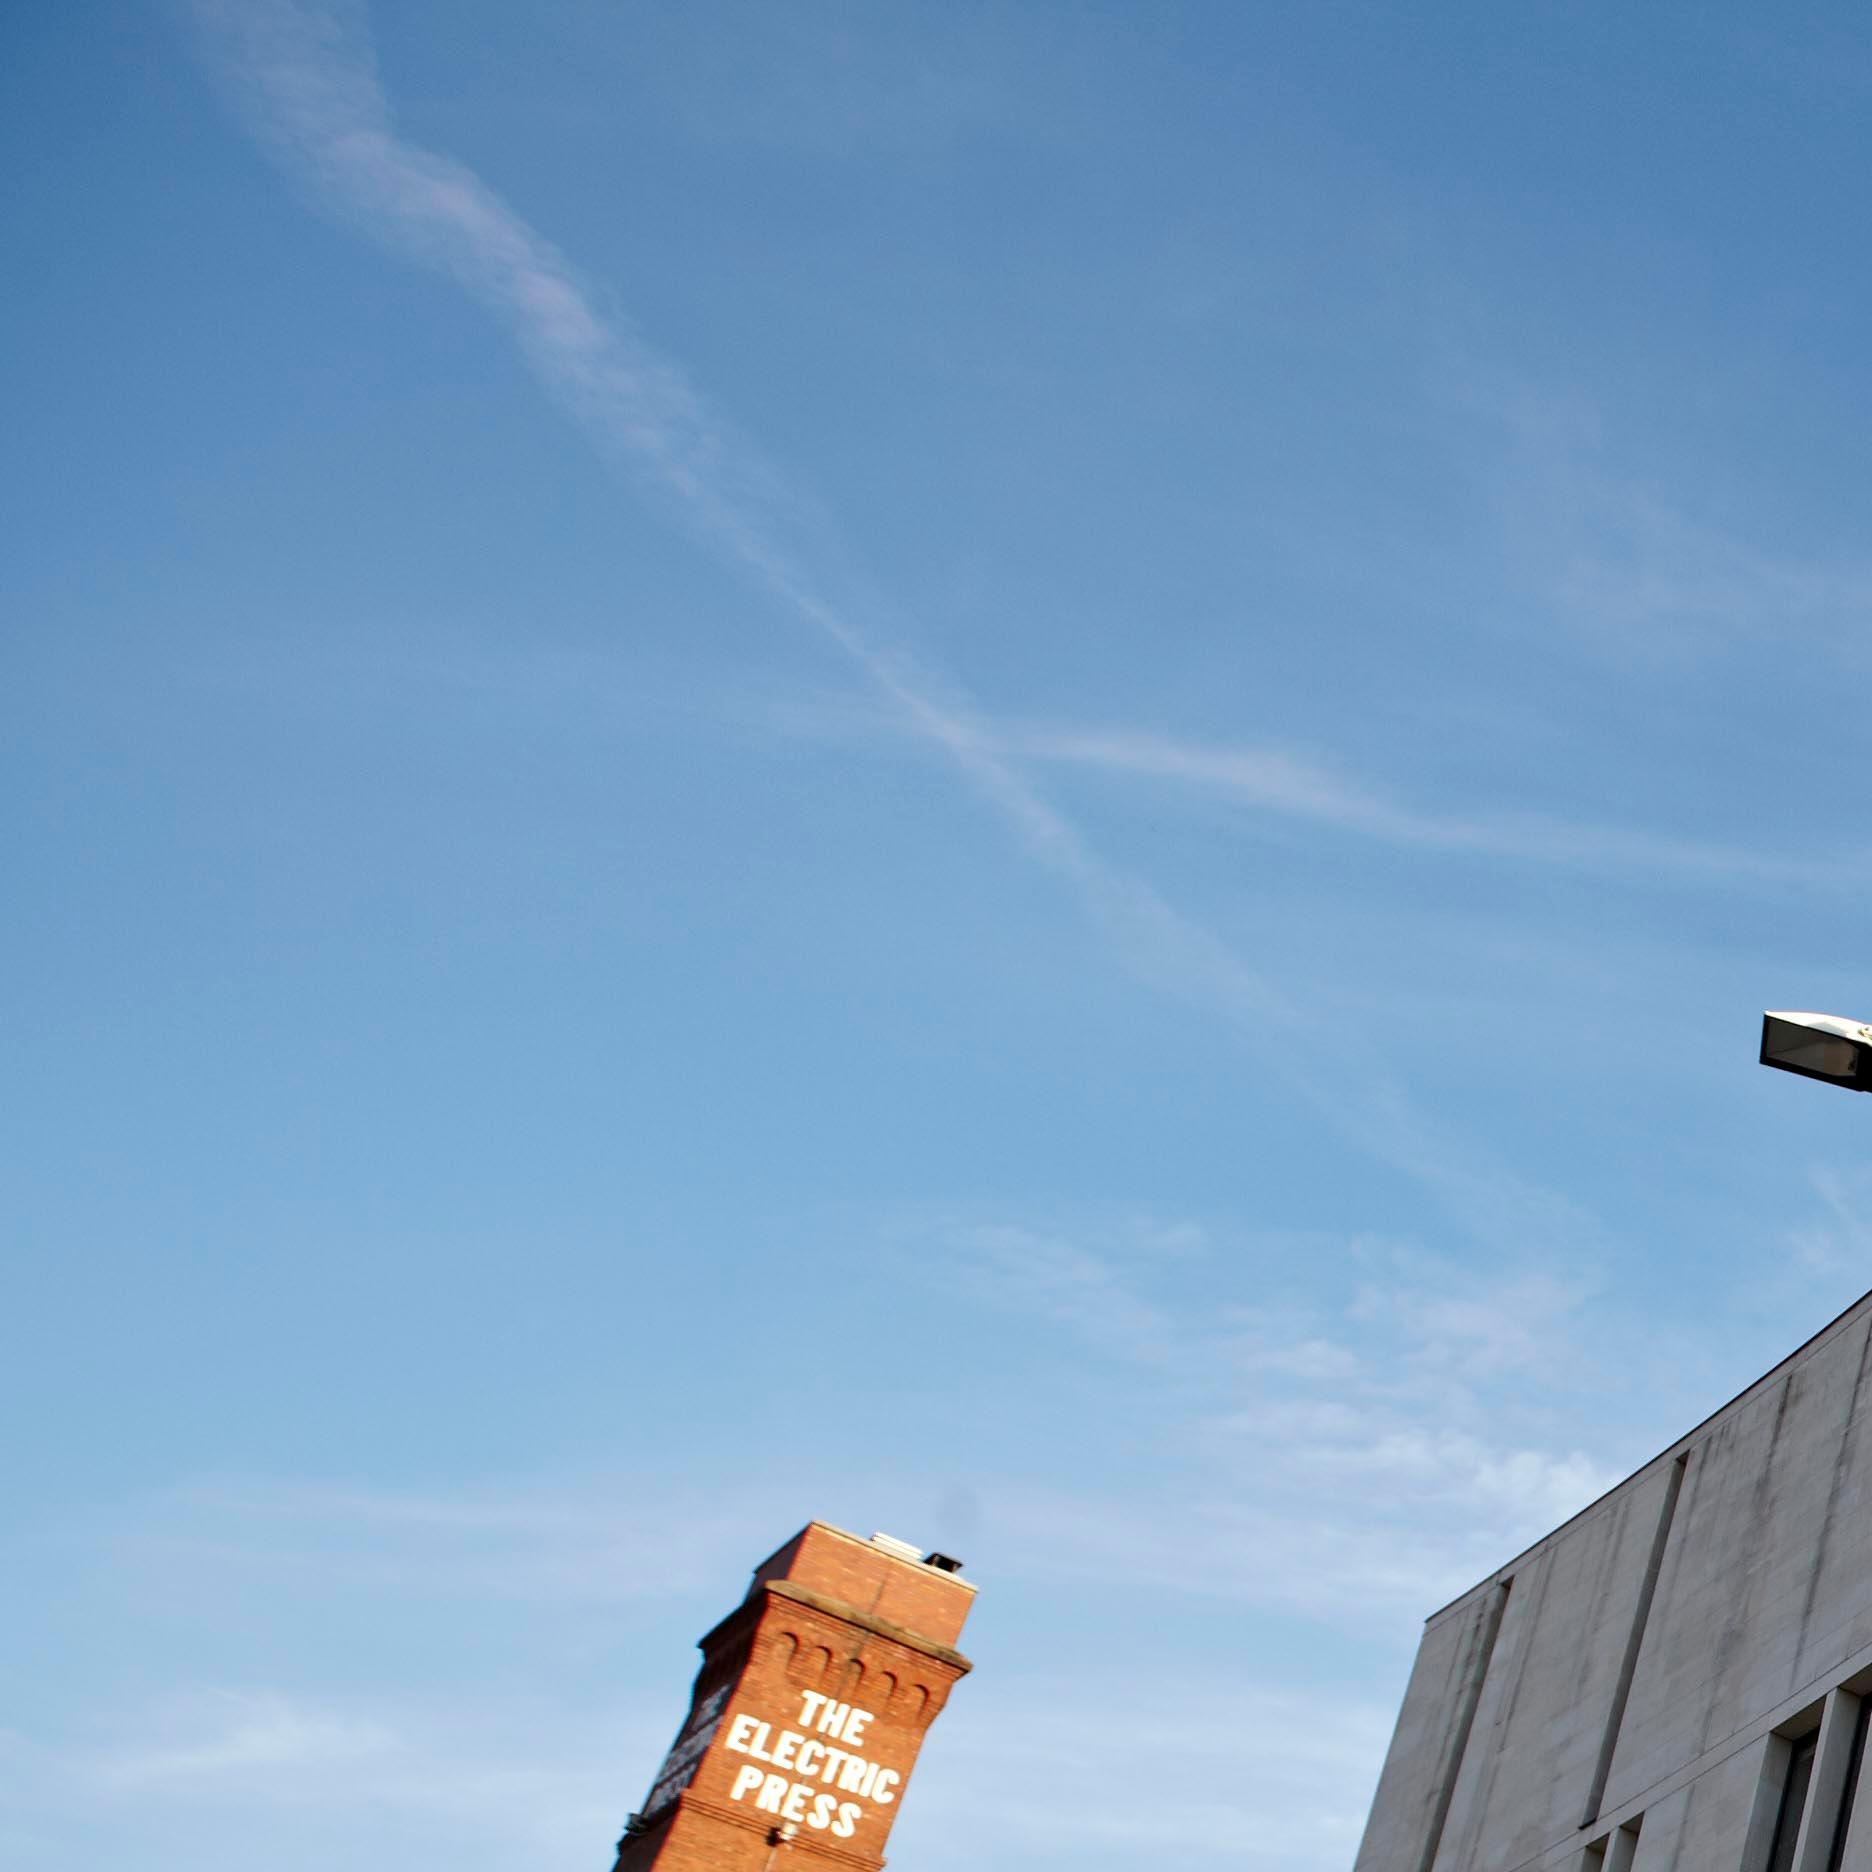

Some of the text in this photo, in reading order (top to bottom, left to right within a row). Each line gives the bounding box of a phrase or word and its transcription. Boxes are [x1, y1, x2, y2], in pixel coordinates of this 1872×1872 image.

[800, 1689, 875, 1747] THE
[724, 1713, 900, 1804] ELECTRIC
[729, 1765, 863, 1838] PRESS
